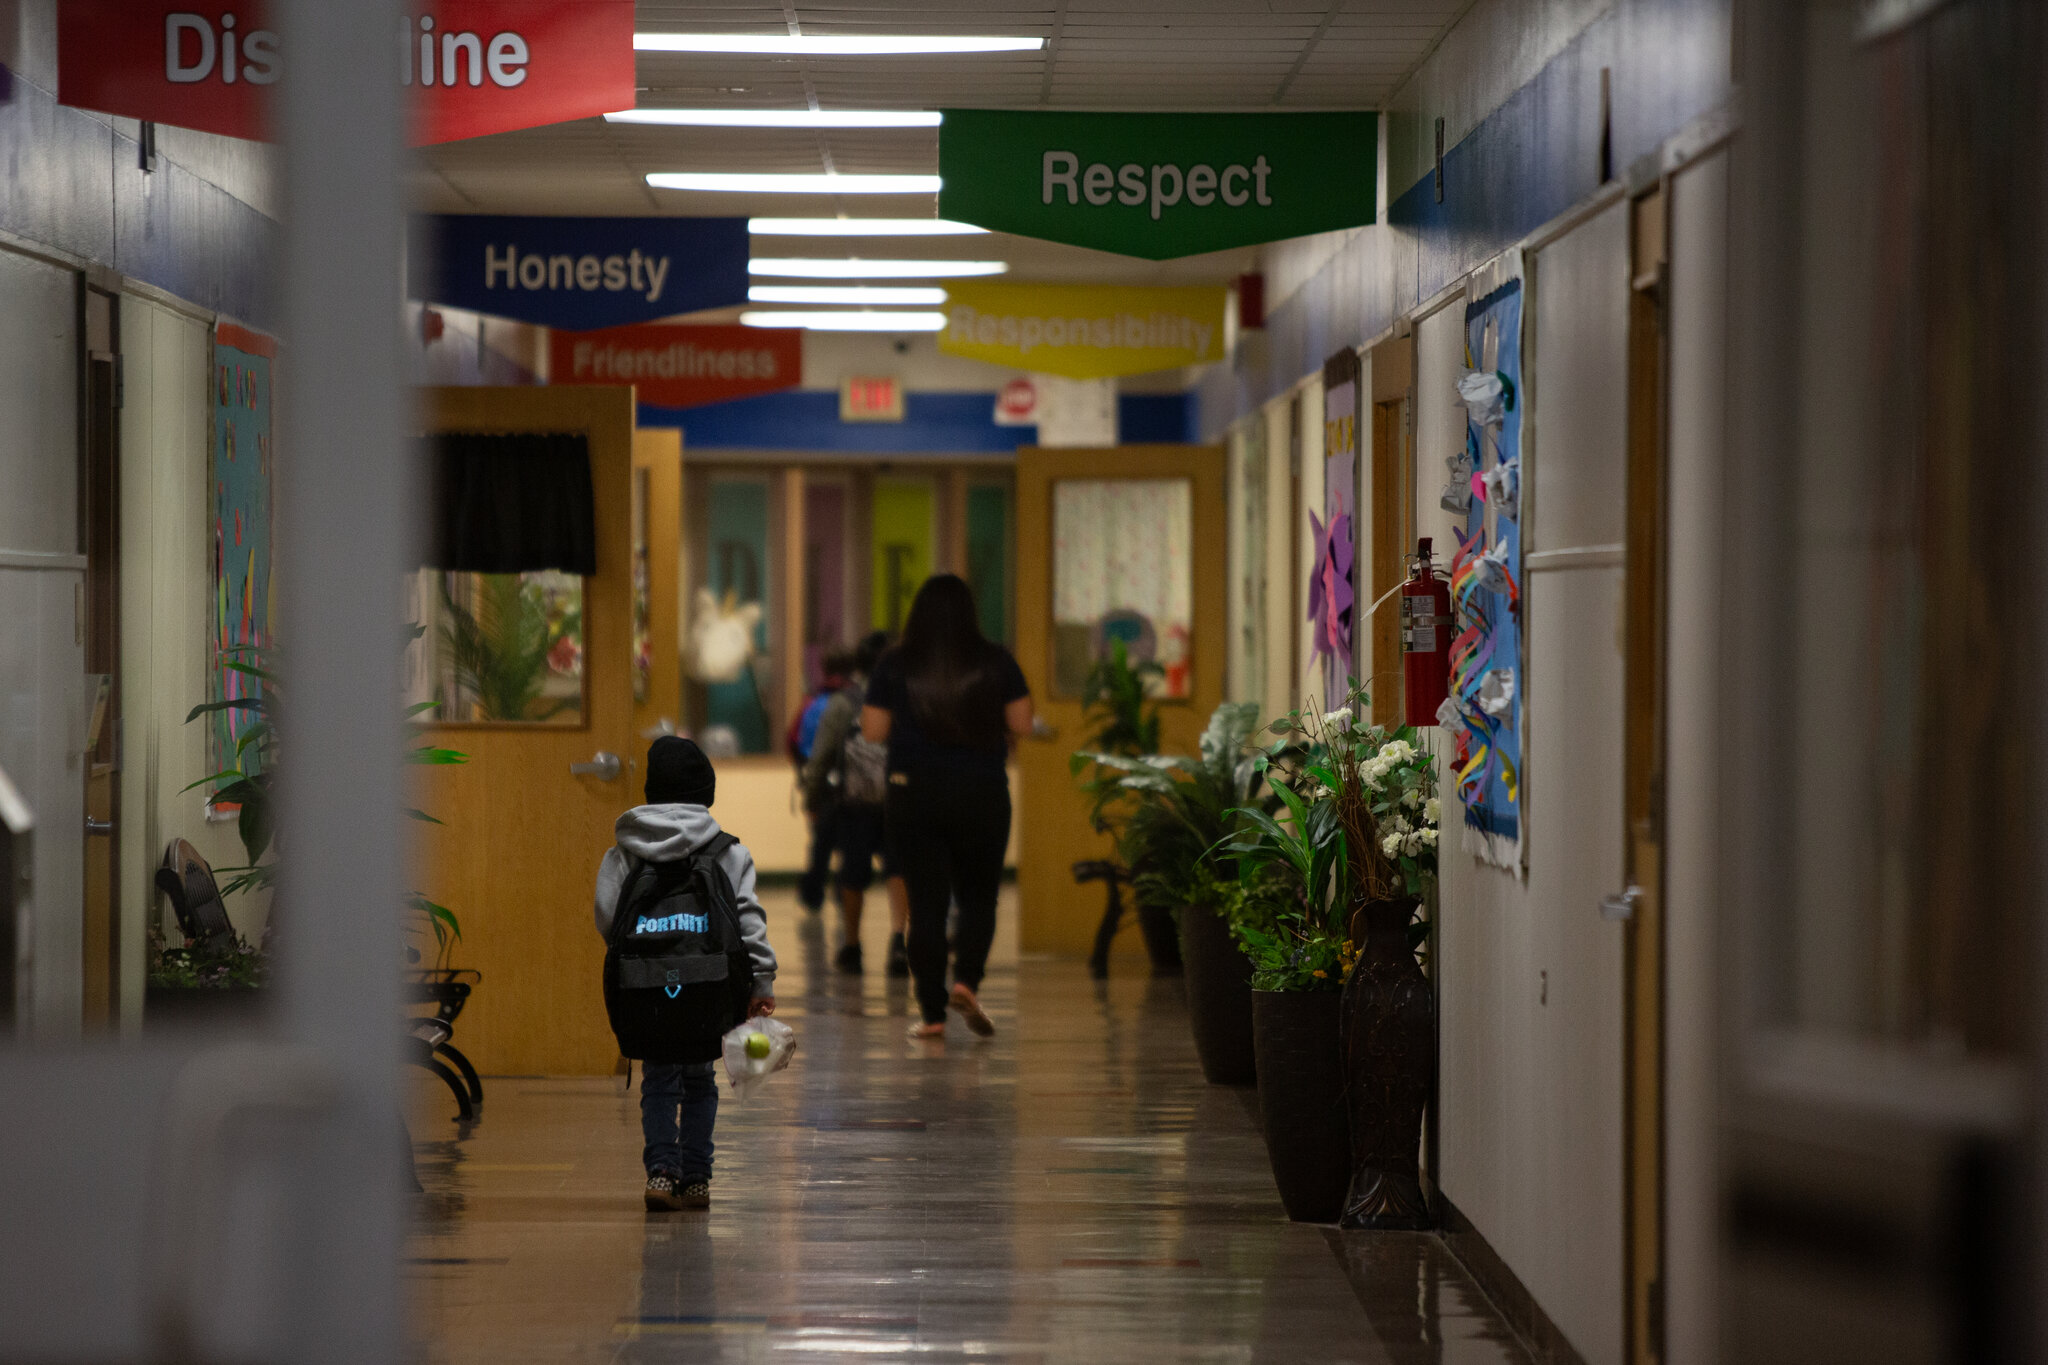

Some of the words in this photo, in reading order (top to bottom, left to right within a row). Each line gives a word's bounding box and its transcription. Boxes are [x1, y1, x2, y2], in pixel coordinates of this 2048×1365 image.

[165, 12, 530, 87] Disline
[1042, 150, 1273, 221] Respect
[484, 243, 671, 303] Honesty
[572, 340, 778, 379] Friendliness
[948, 303, 1214, 360] Responsibility
